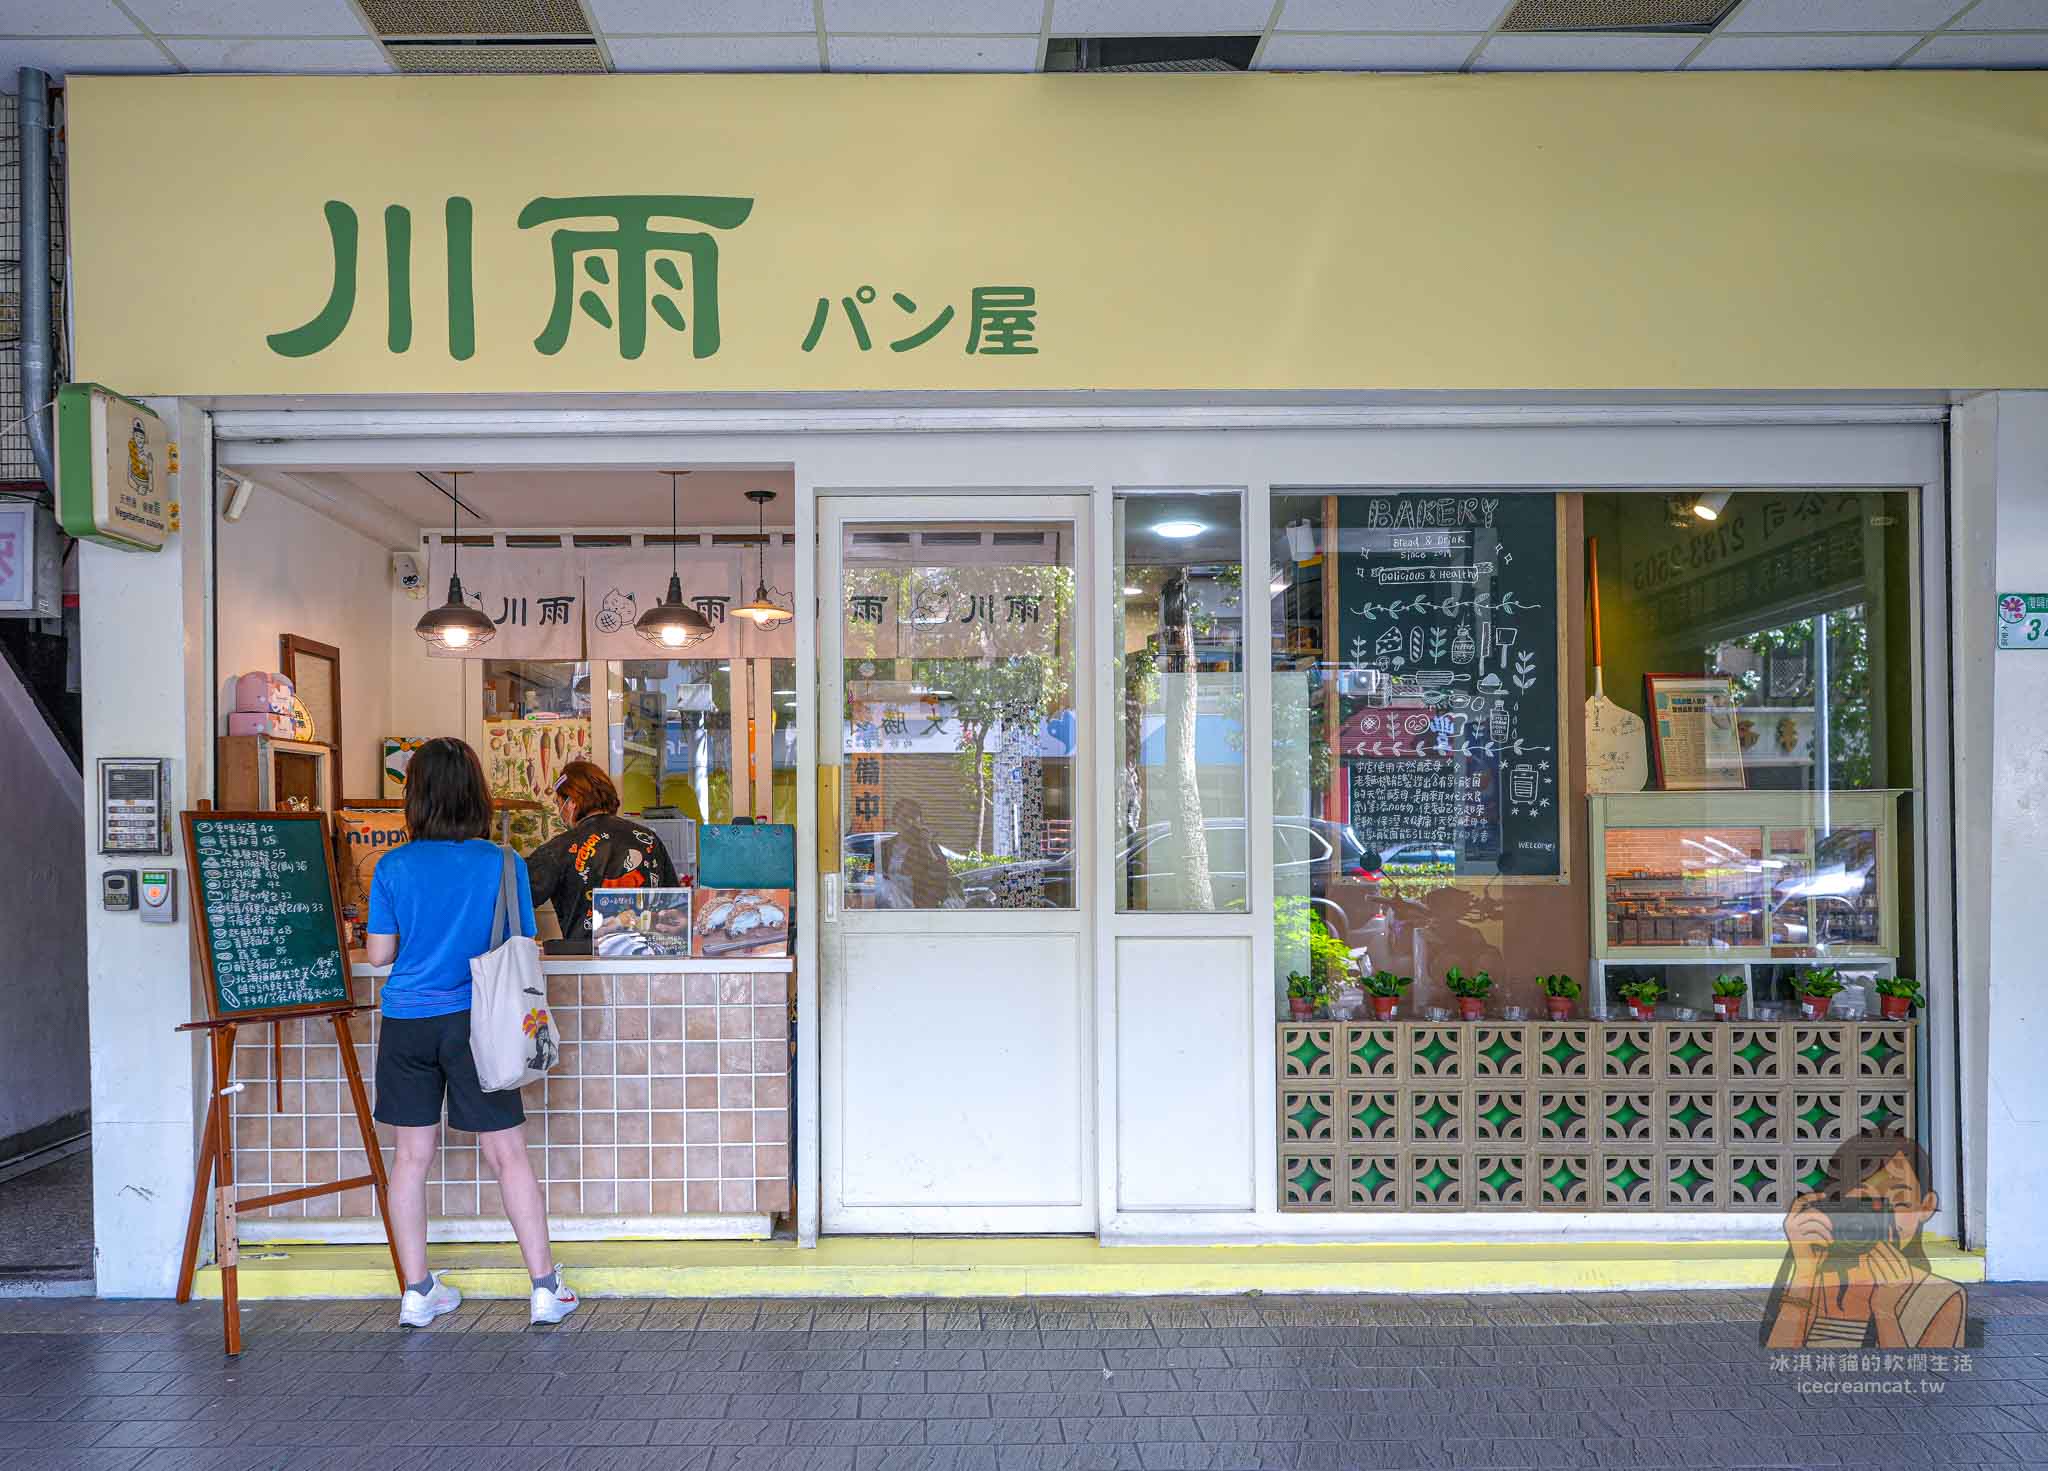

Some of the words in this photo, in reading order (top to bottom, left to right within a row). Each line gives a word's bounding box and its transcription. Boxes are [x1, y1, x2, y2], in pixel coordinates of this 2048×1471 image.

[266, 195, 754, 361] 川雨
[801, 285, 1040, 355] パン屋
[1368, 498, 1499, 531] BAKERY
[1425, 535, 1432, 545] &
[1429, 569, 1437, 580] &
[493, 596, 577, 627] 川雨
[961, 594, 1044, 626] 川雨
[2027, 618, 2048, 641] 3
[262, 836, 278, 846] 55
[272, 849, 286, 859] 55
